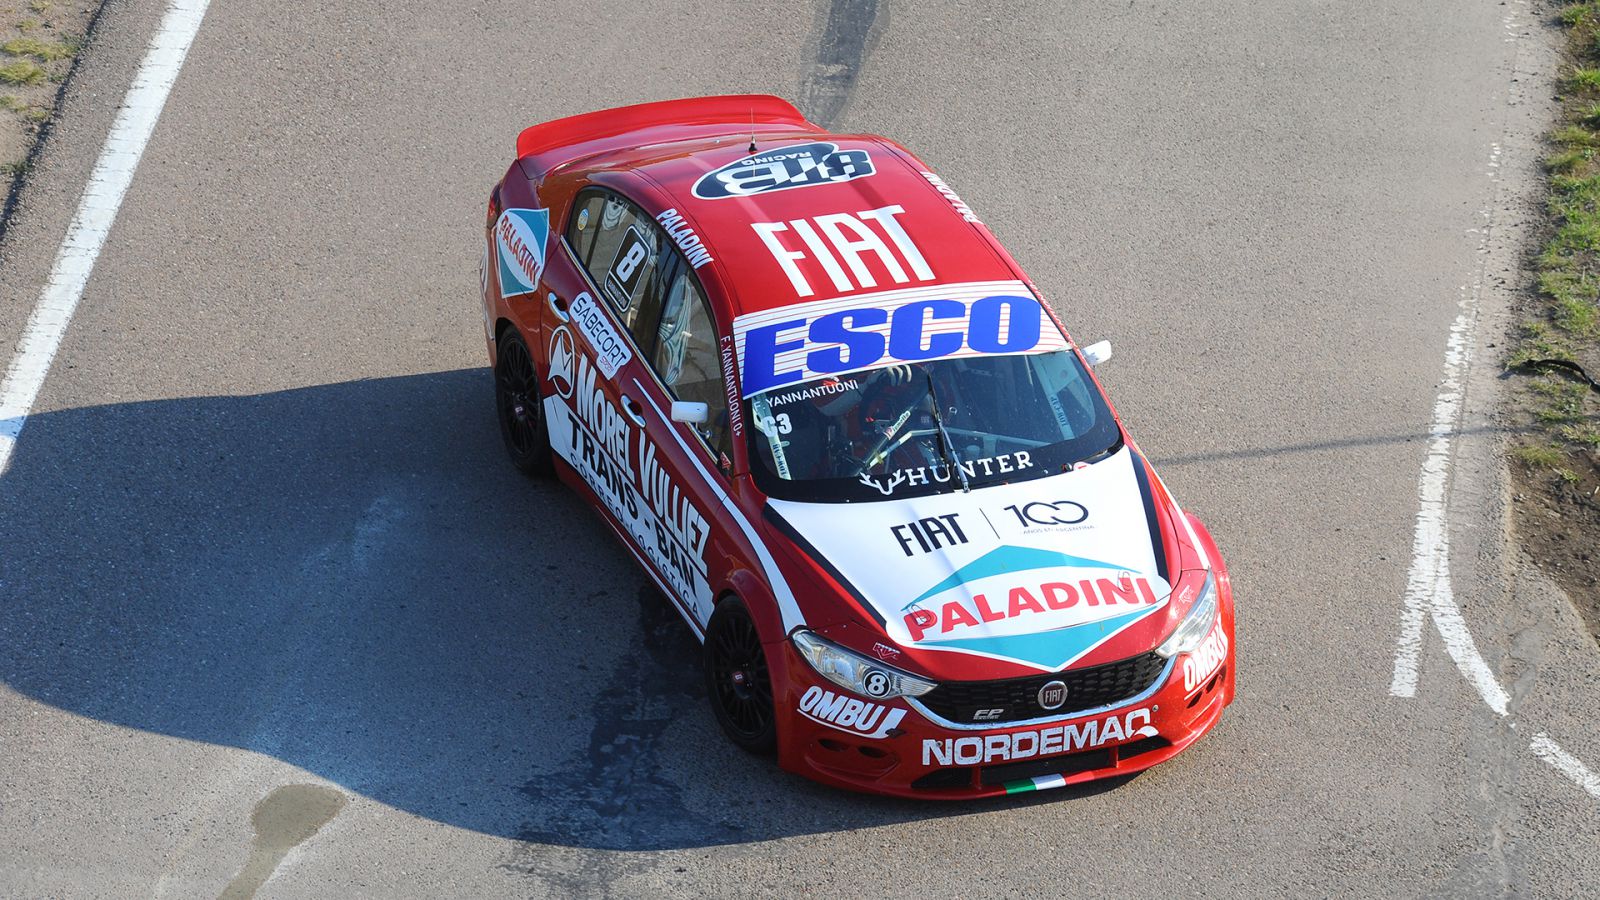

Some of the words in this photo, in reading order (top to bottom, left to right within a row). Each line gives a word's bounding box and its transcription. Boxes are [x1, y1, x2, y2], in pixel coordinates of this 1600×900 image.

[740, 151, 811, 165] RACING
[499, 214, 541, 286] PALADINI
[616, 241, 646, 283] 8
[655, 208, 714, 270] PALADINI
[750, 204, 936, 297] FIAT
[573, 297, 627, 367] SABECORT
[742, 295, 1041, 399] ESCO
[765, 380, 859, 408] YANNANTUONI
[577, 353, 636, 484] MOREL
[640, 430, 711, 578] VULLIEZ
[905, 450, 1033, 486] HUNTER
[568, 412, 639, 520] TRANS
[655, 518, 697, 599] BAN
[1003, 501, 1089, 527] 100
[890, 513, 969, 557] FIAT
[903, 576, 1157, 642] PALADINI
[868, 671, 886, 693] 8
[1043, 686, 1064, 706] FIAT
[799, 686, 880, 731] OMBU
[922, 707, 1158, 767] NORDEMAQ
